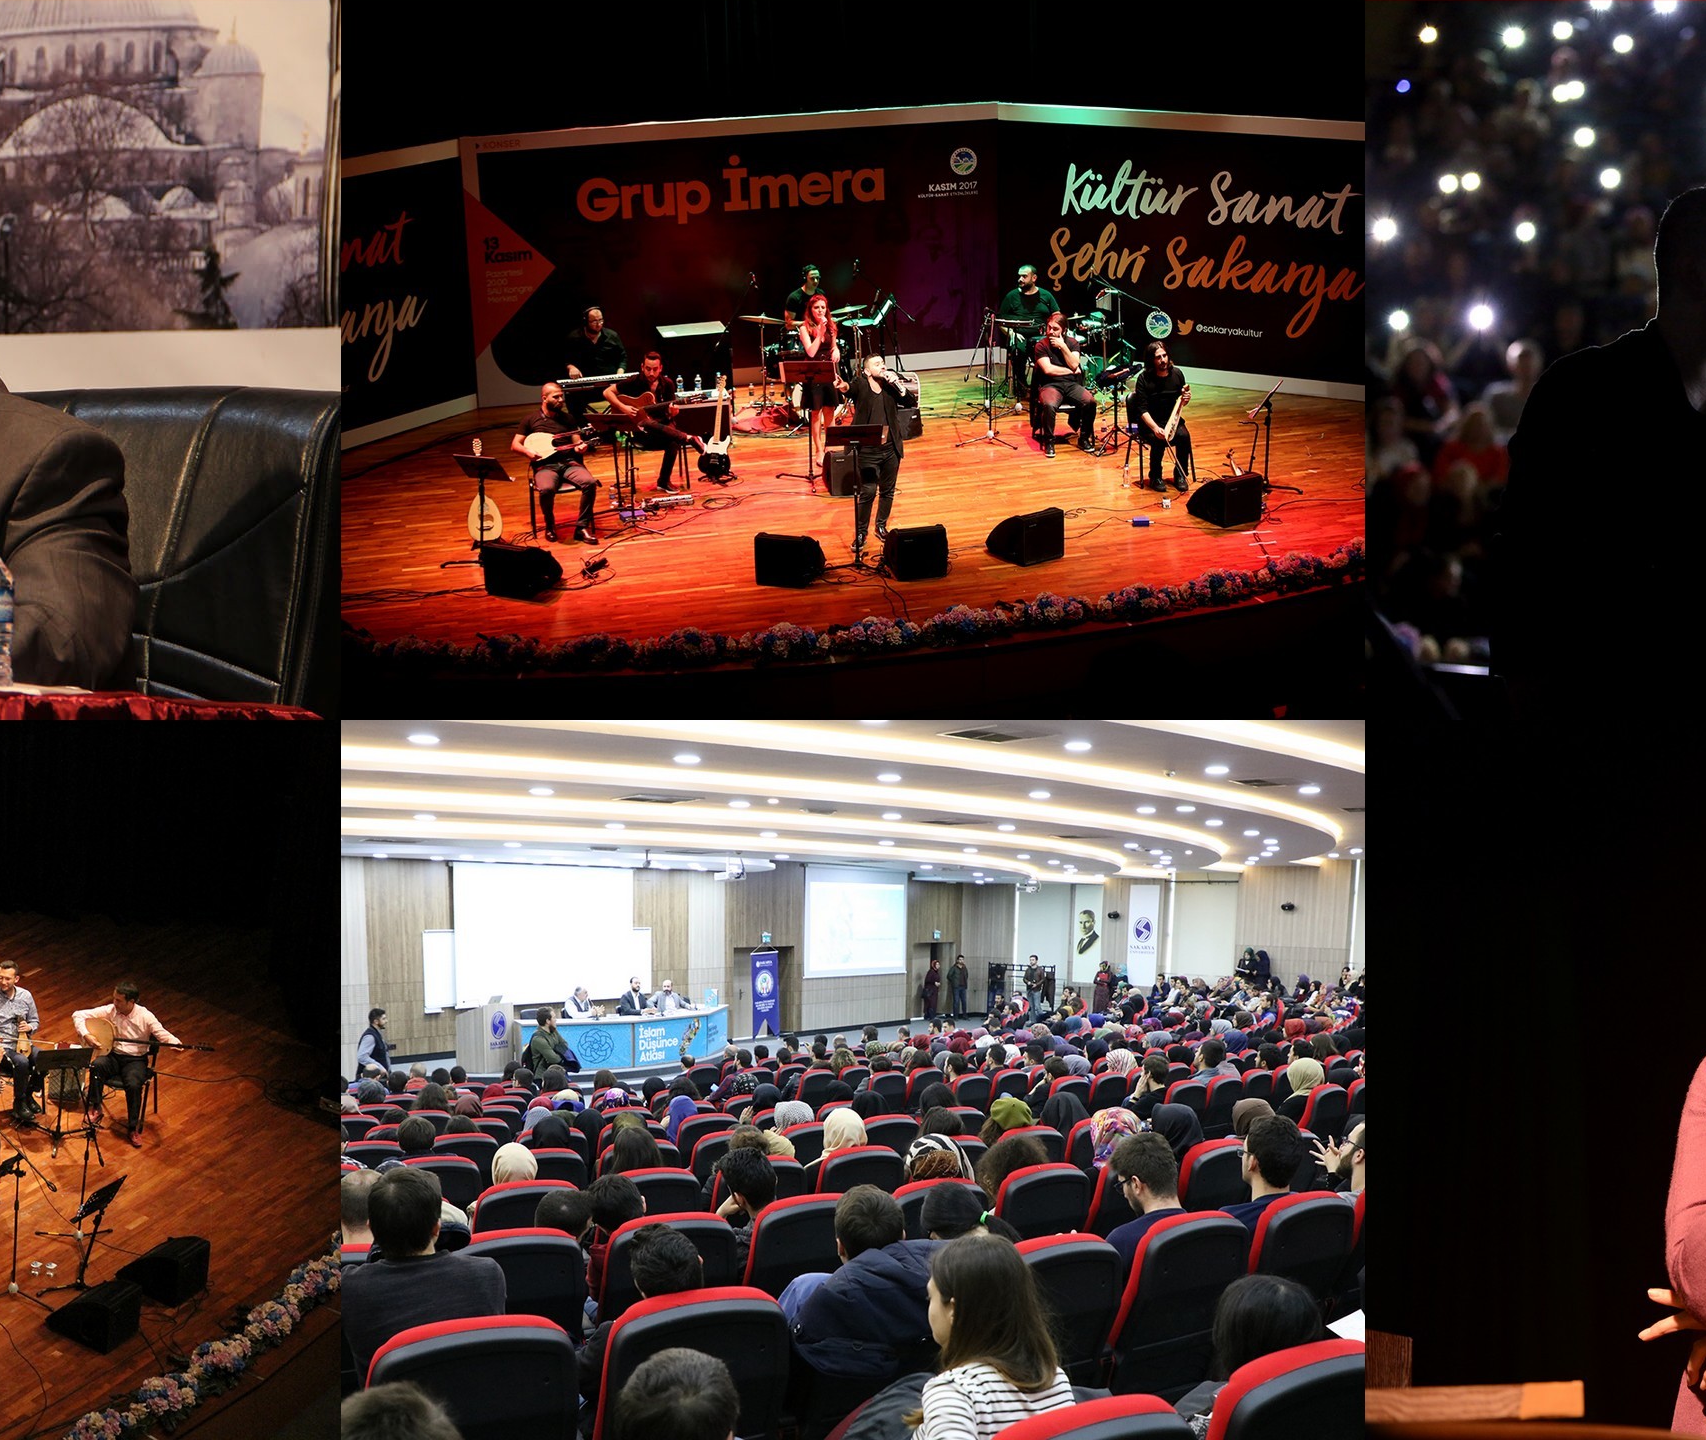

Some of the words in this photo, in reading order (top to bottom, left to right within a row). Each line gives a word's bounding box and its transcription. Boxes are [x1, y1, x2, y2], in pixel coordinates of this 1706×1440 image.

[482, 139, 521, 150] KONSER
[575, 176, 712, 225] Grup
[722, 154, 887, 213] İmera
[928, 183, 957, 192] KASIM
[959, 181, 978, 190] 2017
[1061, 159, 1199, 220] Kültür
[1207, 170, 1364, 235] Sanat
[483, 237, 499, 250] 13
[485, 250, 533, 263] Kasım
[1047, 222, 1151, 292] Şehri
[1163, 235, 1365, 339] Sakarya
[1195, 323, 1264, 338] @sakaryakultur
[638, 1024, 665, 1039] İslam
[638, 1037, 679, 1054] Düşünce
[639, 1050, 665, 1063] Atlası
